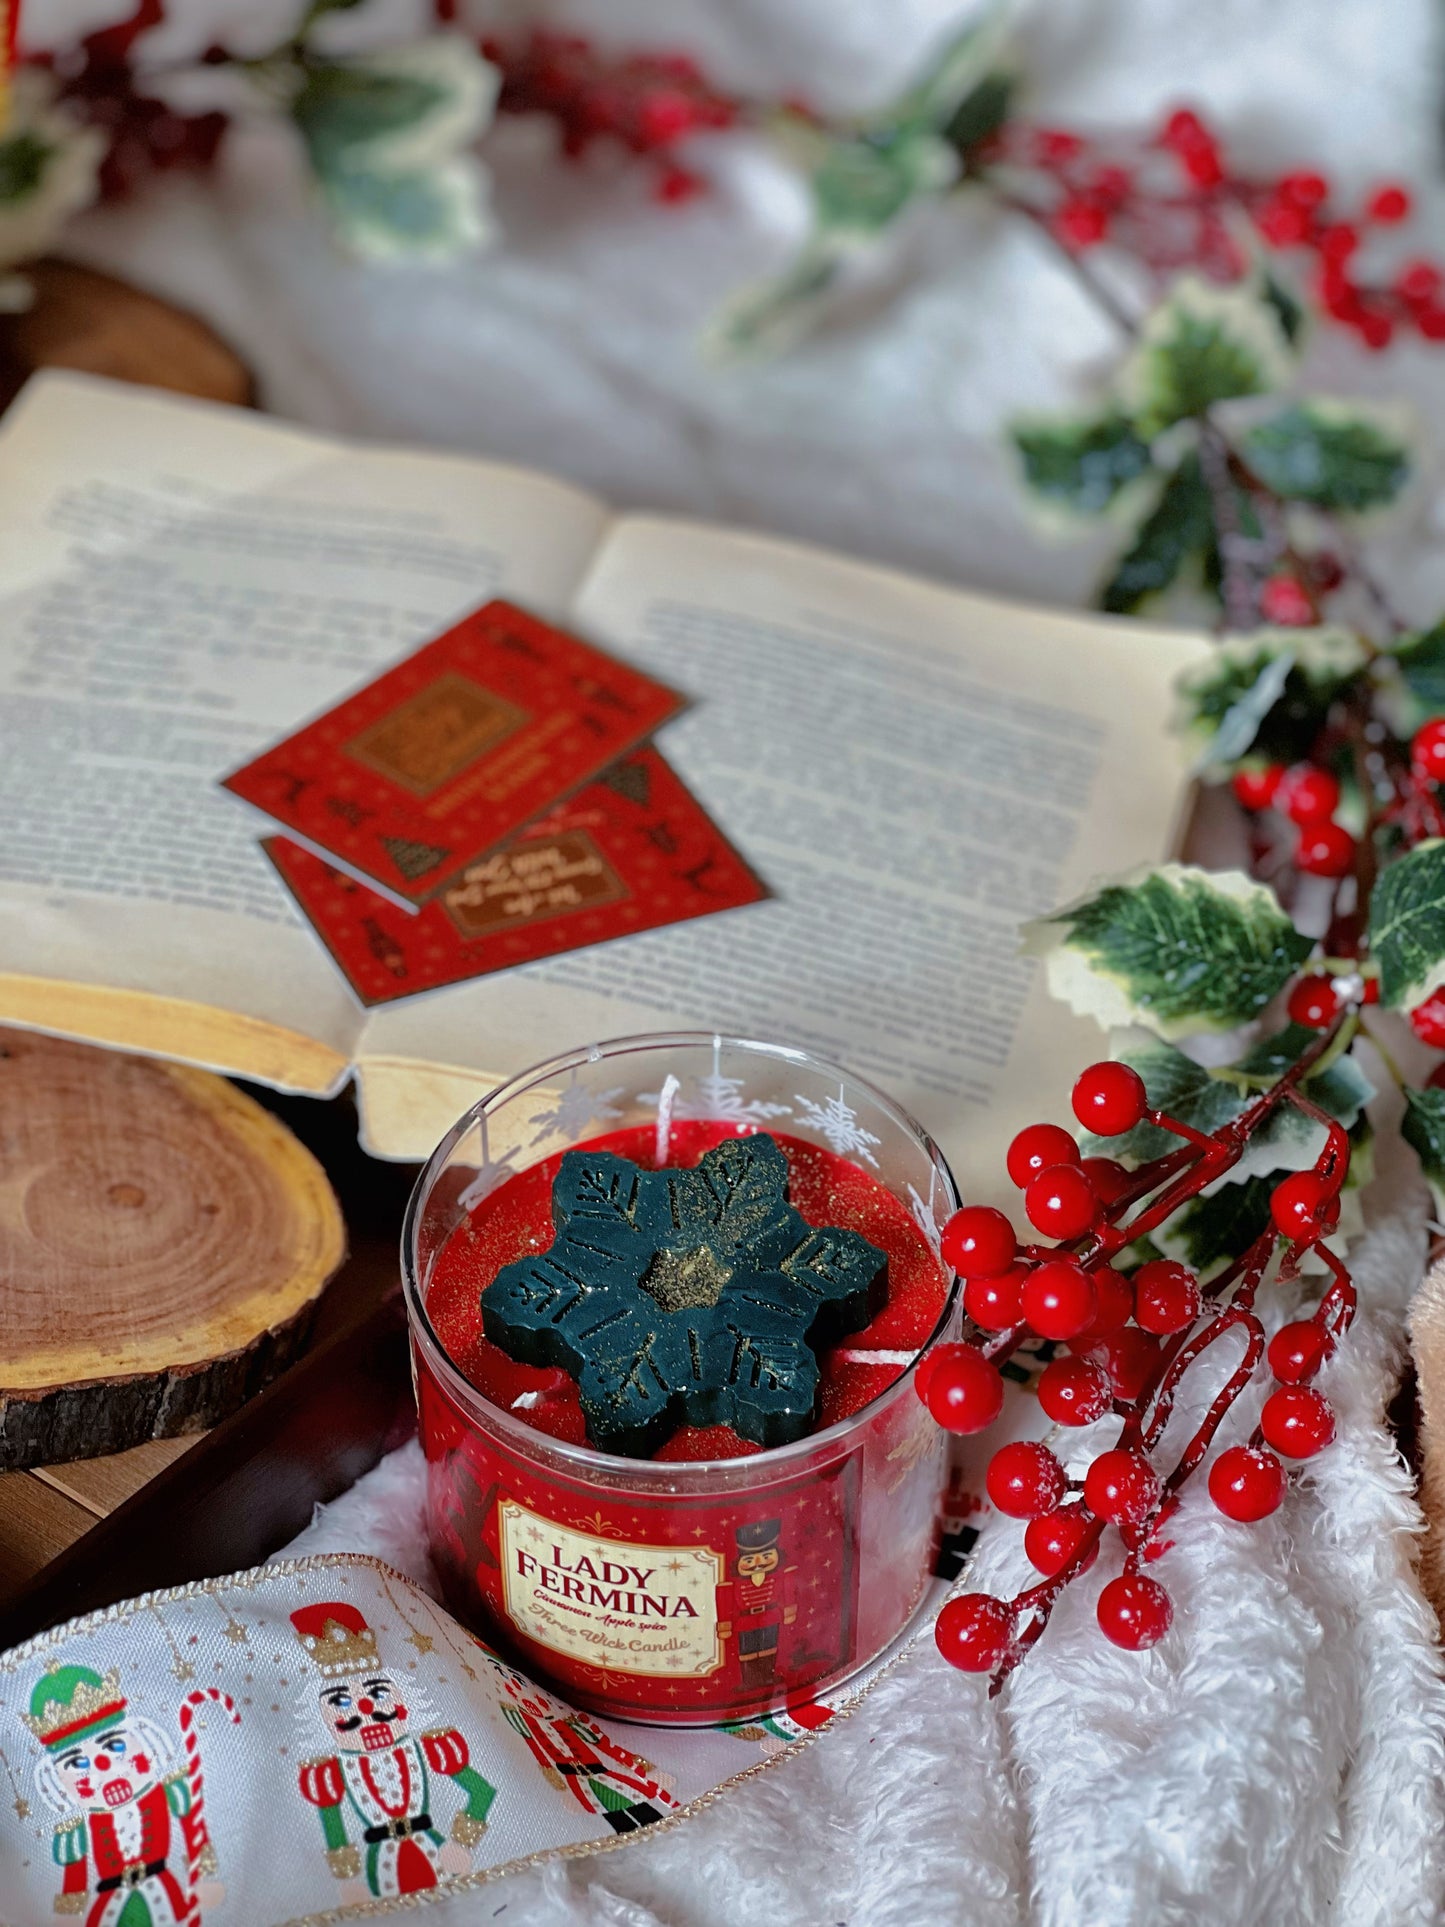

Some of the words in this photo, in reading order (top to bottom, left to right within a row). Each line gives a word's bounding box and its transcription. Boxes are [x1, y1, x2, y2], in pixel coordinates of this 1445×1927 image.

[515, 1548, 700, 1618] FERMINA
[552, 1544, 657, 1589] LADY
[527, 1602, 578, 1637] Three
[580, 1629, 627, 1651] Wick
[629, 1638, 691, 1653] Candle
[533, 1588, 593, 1618] Cinnamon
[595, 1613, 636, 1629] Apple
